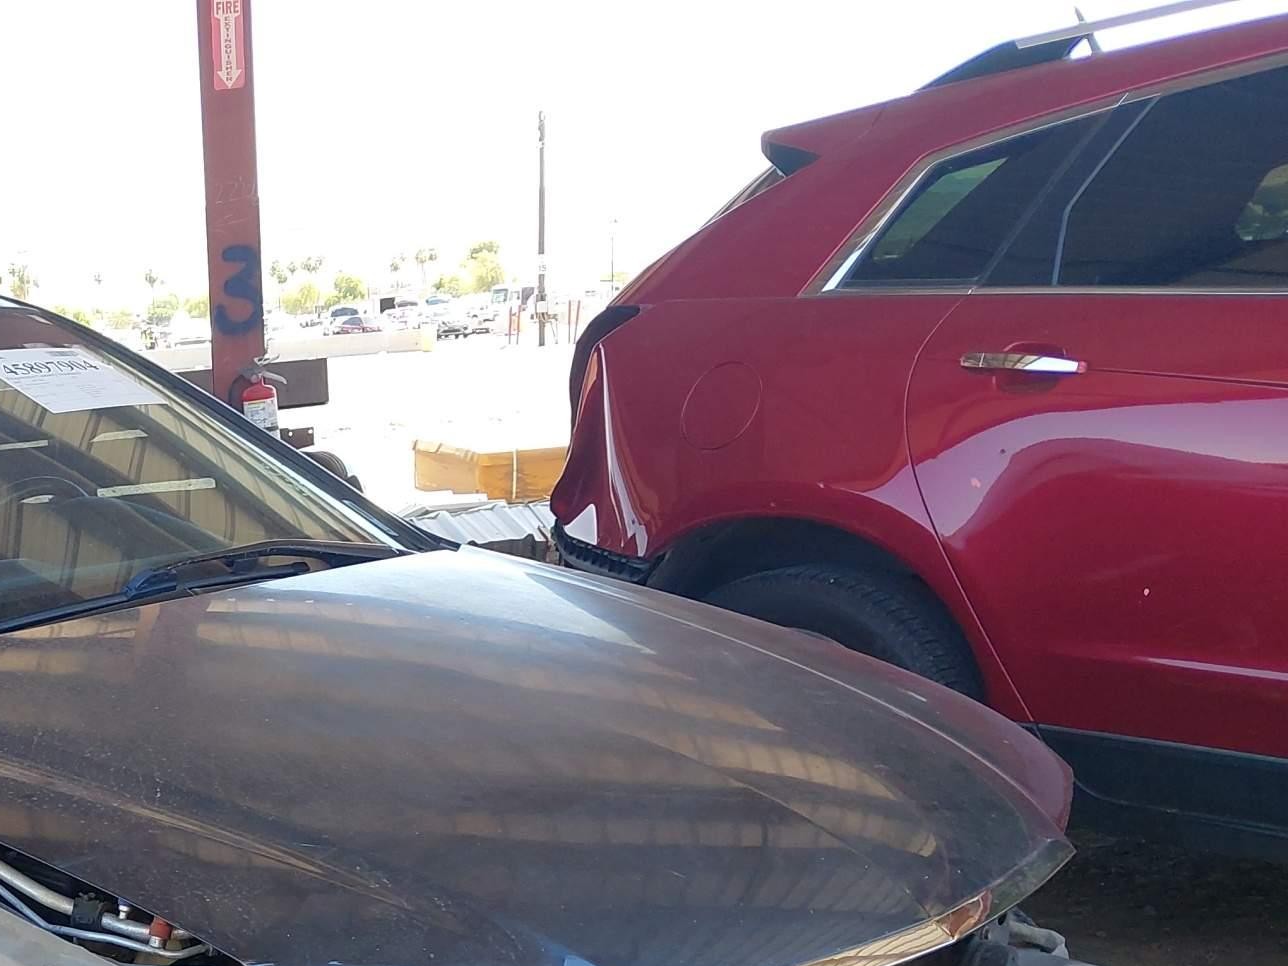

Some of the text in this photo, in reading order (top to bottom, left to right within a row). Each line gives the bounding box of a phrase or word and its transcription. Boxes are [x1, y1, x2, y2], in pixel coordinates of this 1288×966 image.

[215, 1, 239, 15] FIRE
[224, 16, 233, 82] EXTINGUISHER
[215, 243, 260, 335] 3
[2, 359, 99, 376] 45897904
